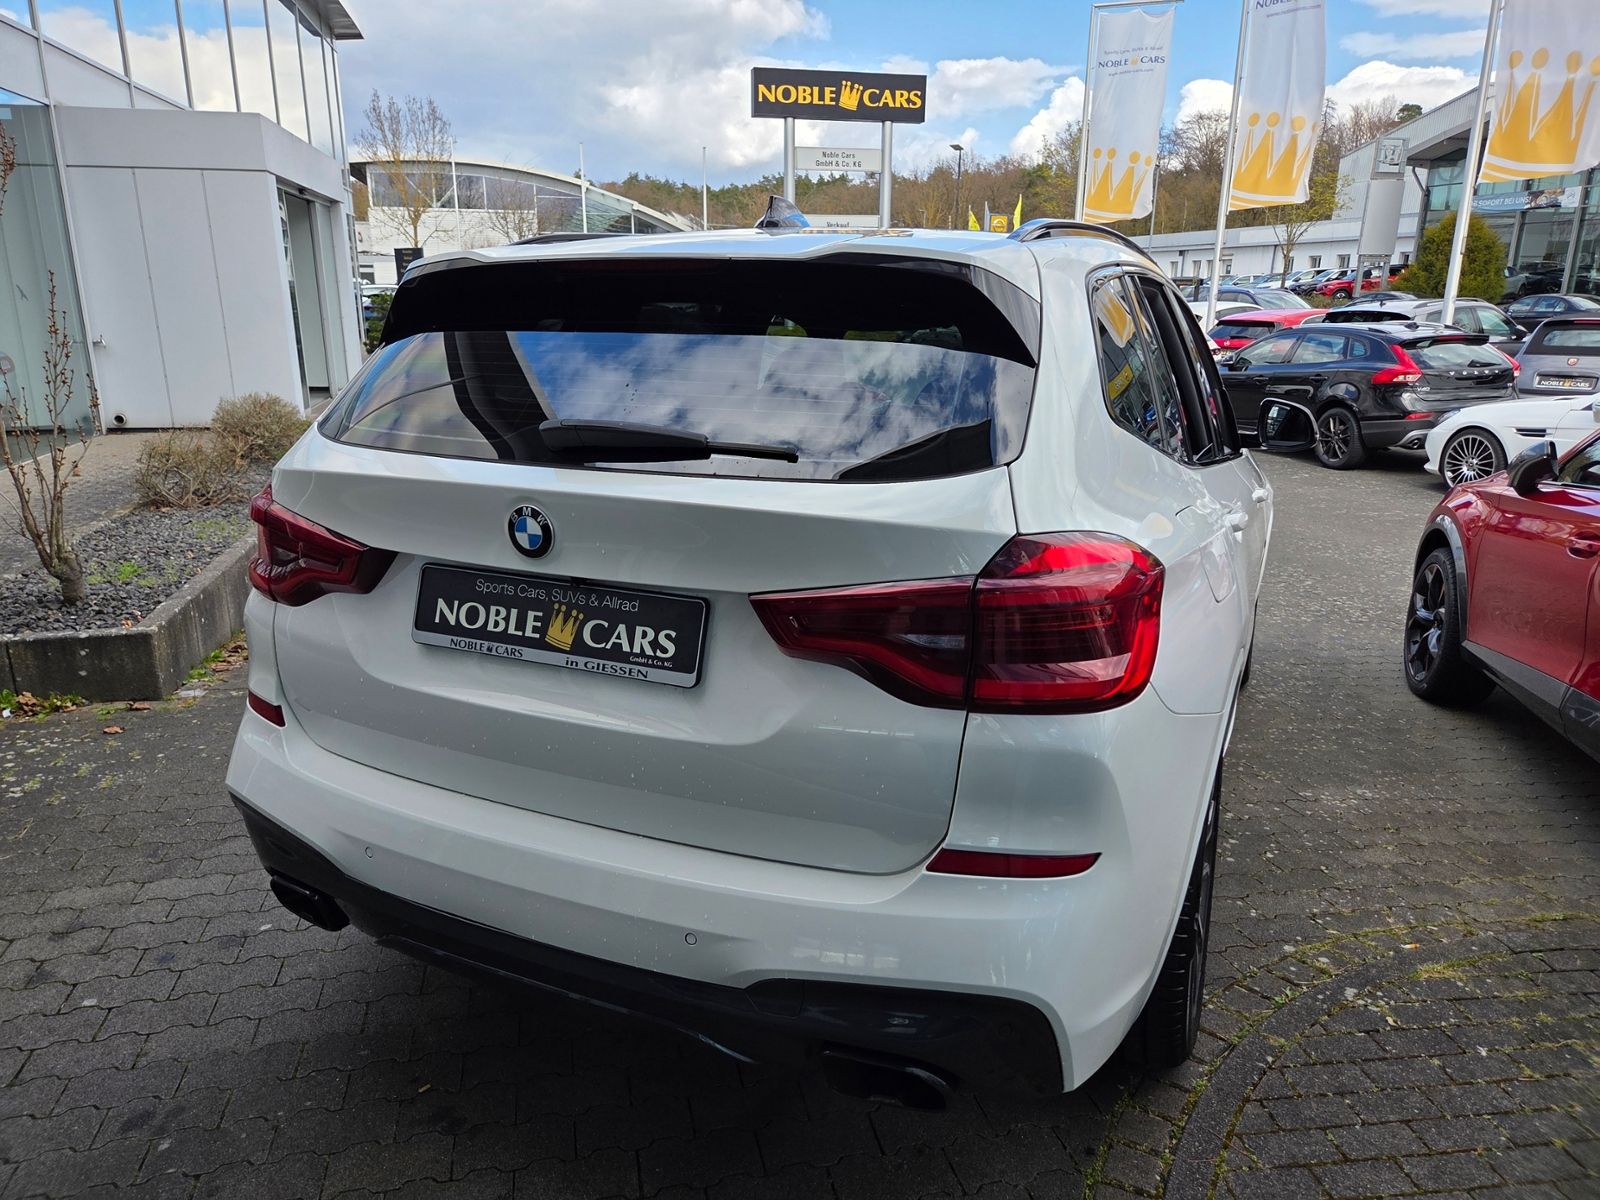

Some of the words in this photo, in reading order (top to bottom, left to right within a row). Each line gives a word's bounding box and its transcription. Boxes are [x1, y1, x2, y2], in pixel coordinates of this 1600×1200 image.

[1098, 58, 1128, 69] NOBLE
[1140, 55, 1166, 64] CARS
[757, 84, 836, 105] NOBLE
[863, 88, 922, 109] CARS
[822, 151, 839, 159] Noble
[841, 160, 851, 168] Co.
[511, 506, 548, 526] BMW
[475, 578, 515, 595] Sports
[517, 584, 549, 601] Cars,
[551, 588, 586, 605] SUVs
[588, 593, 599, 607] &
[601, 595, 640, 612] Allrad
[434, 598, 543, 638] NOBLE
[582, 619, 677, 658] CARS
[450, 638, 485, 652] NOBLE
[495, 645, 524, 657] CARS
[565, 656, 579, 668] in
[583, 661, 649, 679] GIESSEN
[629, 655, 647, 665] GmbH
